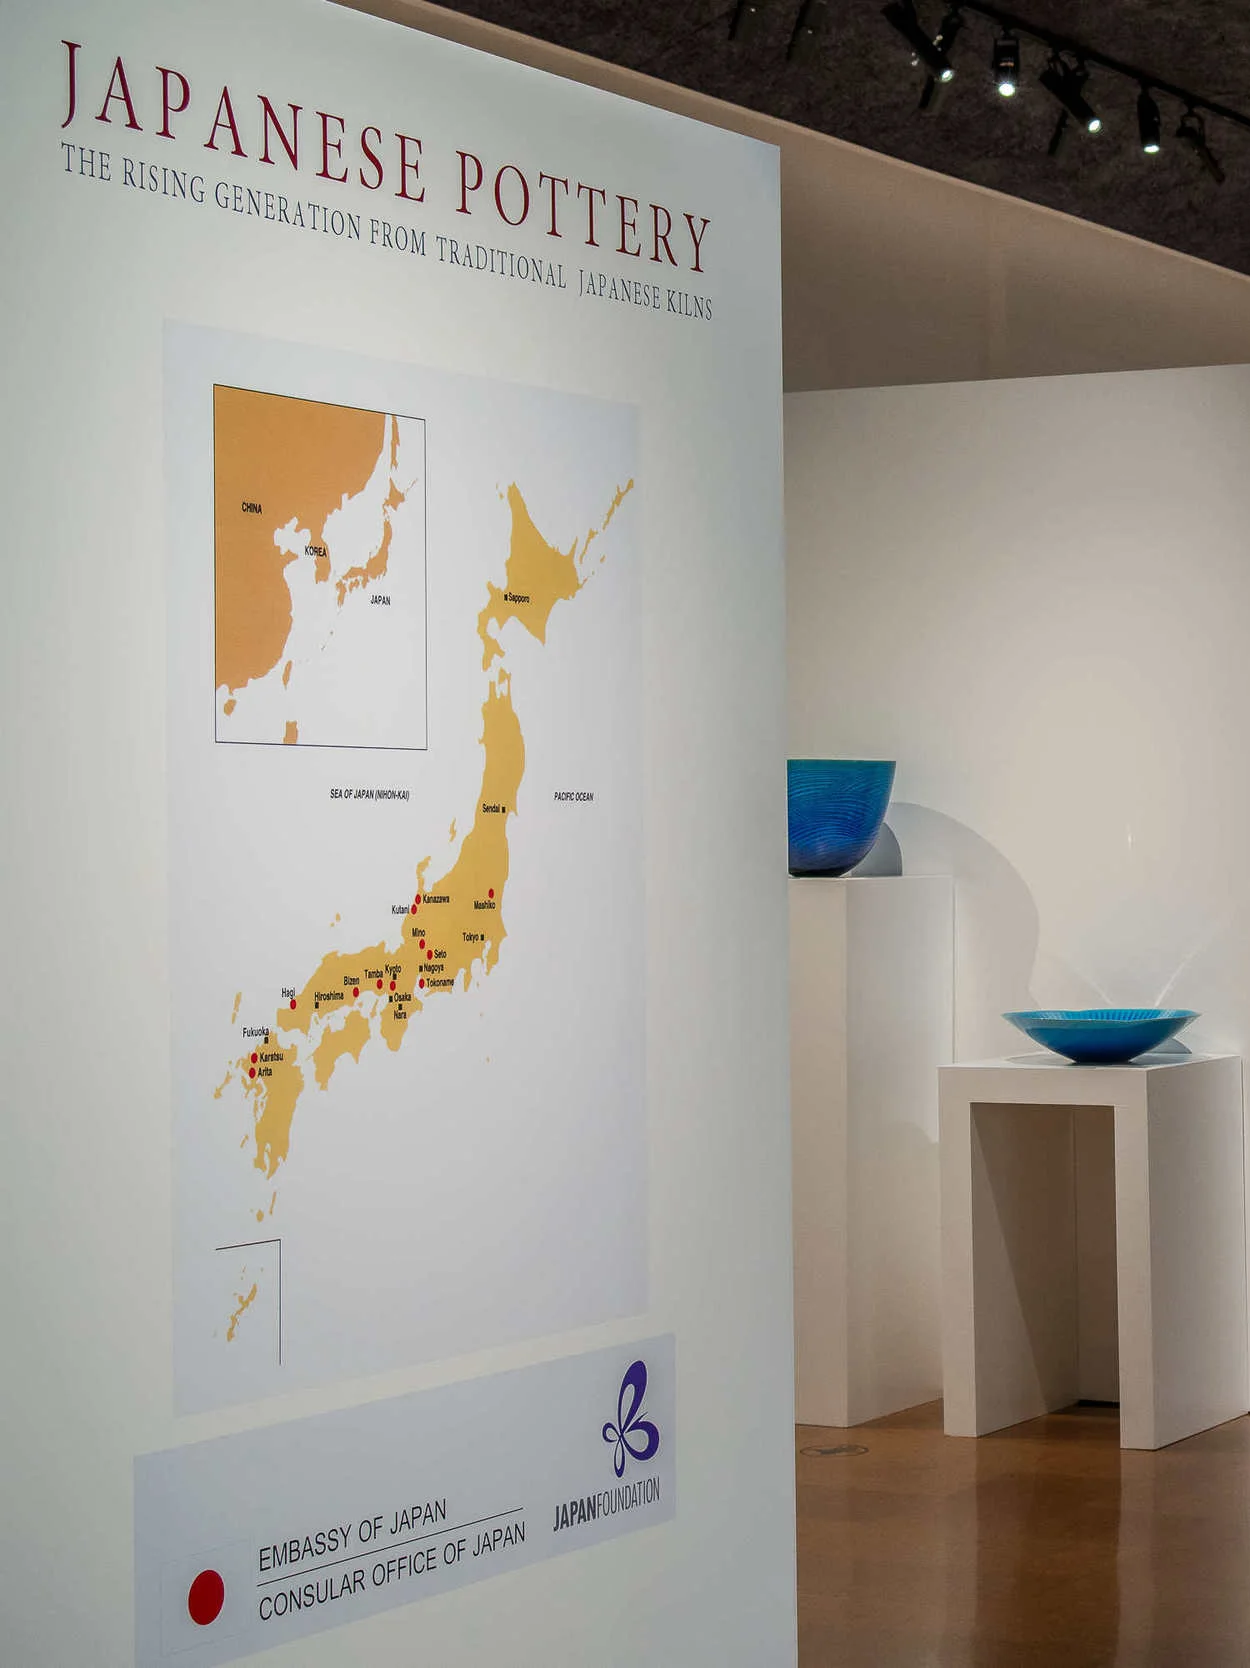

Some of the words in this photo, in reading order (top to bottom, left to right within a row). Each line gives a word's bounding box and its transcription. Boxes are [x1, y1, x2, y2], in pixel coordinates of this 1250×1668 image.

[60, 40, 426, 203] JAPANESE
[455, 150, 712, 274] POTTERY
[61, 142, 112, 182] THE
[122, 157, 206, 204] RISING
[215, 182, 362, 242] GENERATION
[369, 218, 428, 257] FROM
[435, 235, 567, 290] TRADITIONAL
[577, 269, 661, 312] JAPANESE
[666, 289, 714, 321] KILNS
[241, 502, 263, 514] CHINA
[304, 545, 328, 558] KOREA
[370, 595, 391, 606] JAPAN
[508, 592, 530, 604] Sapporo
[330, 788, 343, 799] SEA
[344, 789, 353, 799] OF
[353, 789, 374, 800] JAPAN
[374, 789, 410, 802] (NIHON-KAI)
[553, 791, 575, 801] PACIFIC
[575, 792, 595, 802] OCEAN
[482, 803, 501, 814] Sendai
[422, 894, 450, 904] Kanazawa
[391, 905, 410, 915] Kutani
[473, 901, 496, 910] Mashiko
[411, 928, 426, 937] Mino
[462, 932, 480, 943] Tokyo
[434, 949, 447, 959] Seto
[364, 969, 384, 979] Tamba
[385, 964, 402, 976] Kyoto
[423, 963, 444, 974] Nagoya
[343, 976, 360, 986] Bizen
[426, 978, 455, 988] Tokoname
[281, 987, 296, 1000] Hagi
[314, 990, 345, 1001] Hiroshima
[394, 992, 412, 1002] Osaka
[393, 1010, 407, 1020] Nara
[242, 1026, 270, 1038] Fukuoka
[259, 1052, 284, 1063] Karatsu
[258, 1067, 273, 1077] Arita
[258, 1524, 352, 1573] EMBASSY
[358, 1516, 384, 1543] OF
[389, 1498, 447, 1535] JAPAN
[258, 1569, 365, 1622] CONSULAR
[371, 1549, 438, 1588] OFFICE
[443, 1538, 467, 1565] OF
[471, 1520, 527, 1557] JAPAN
